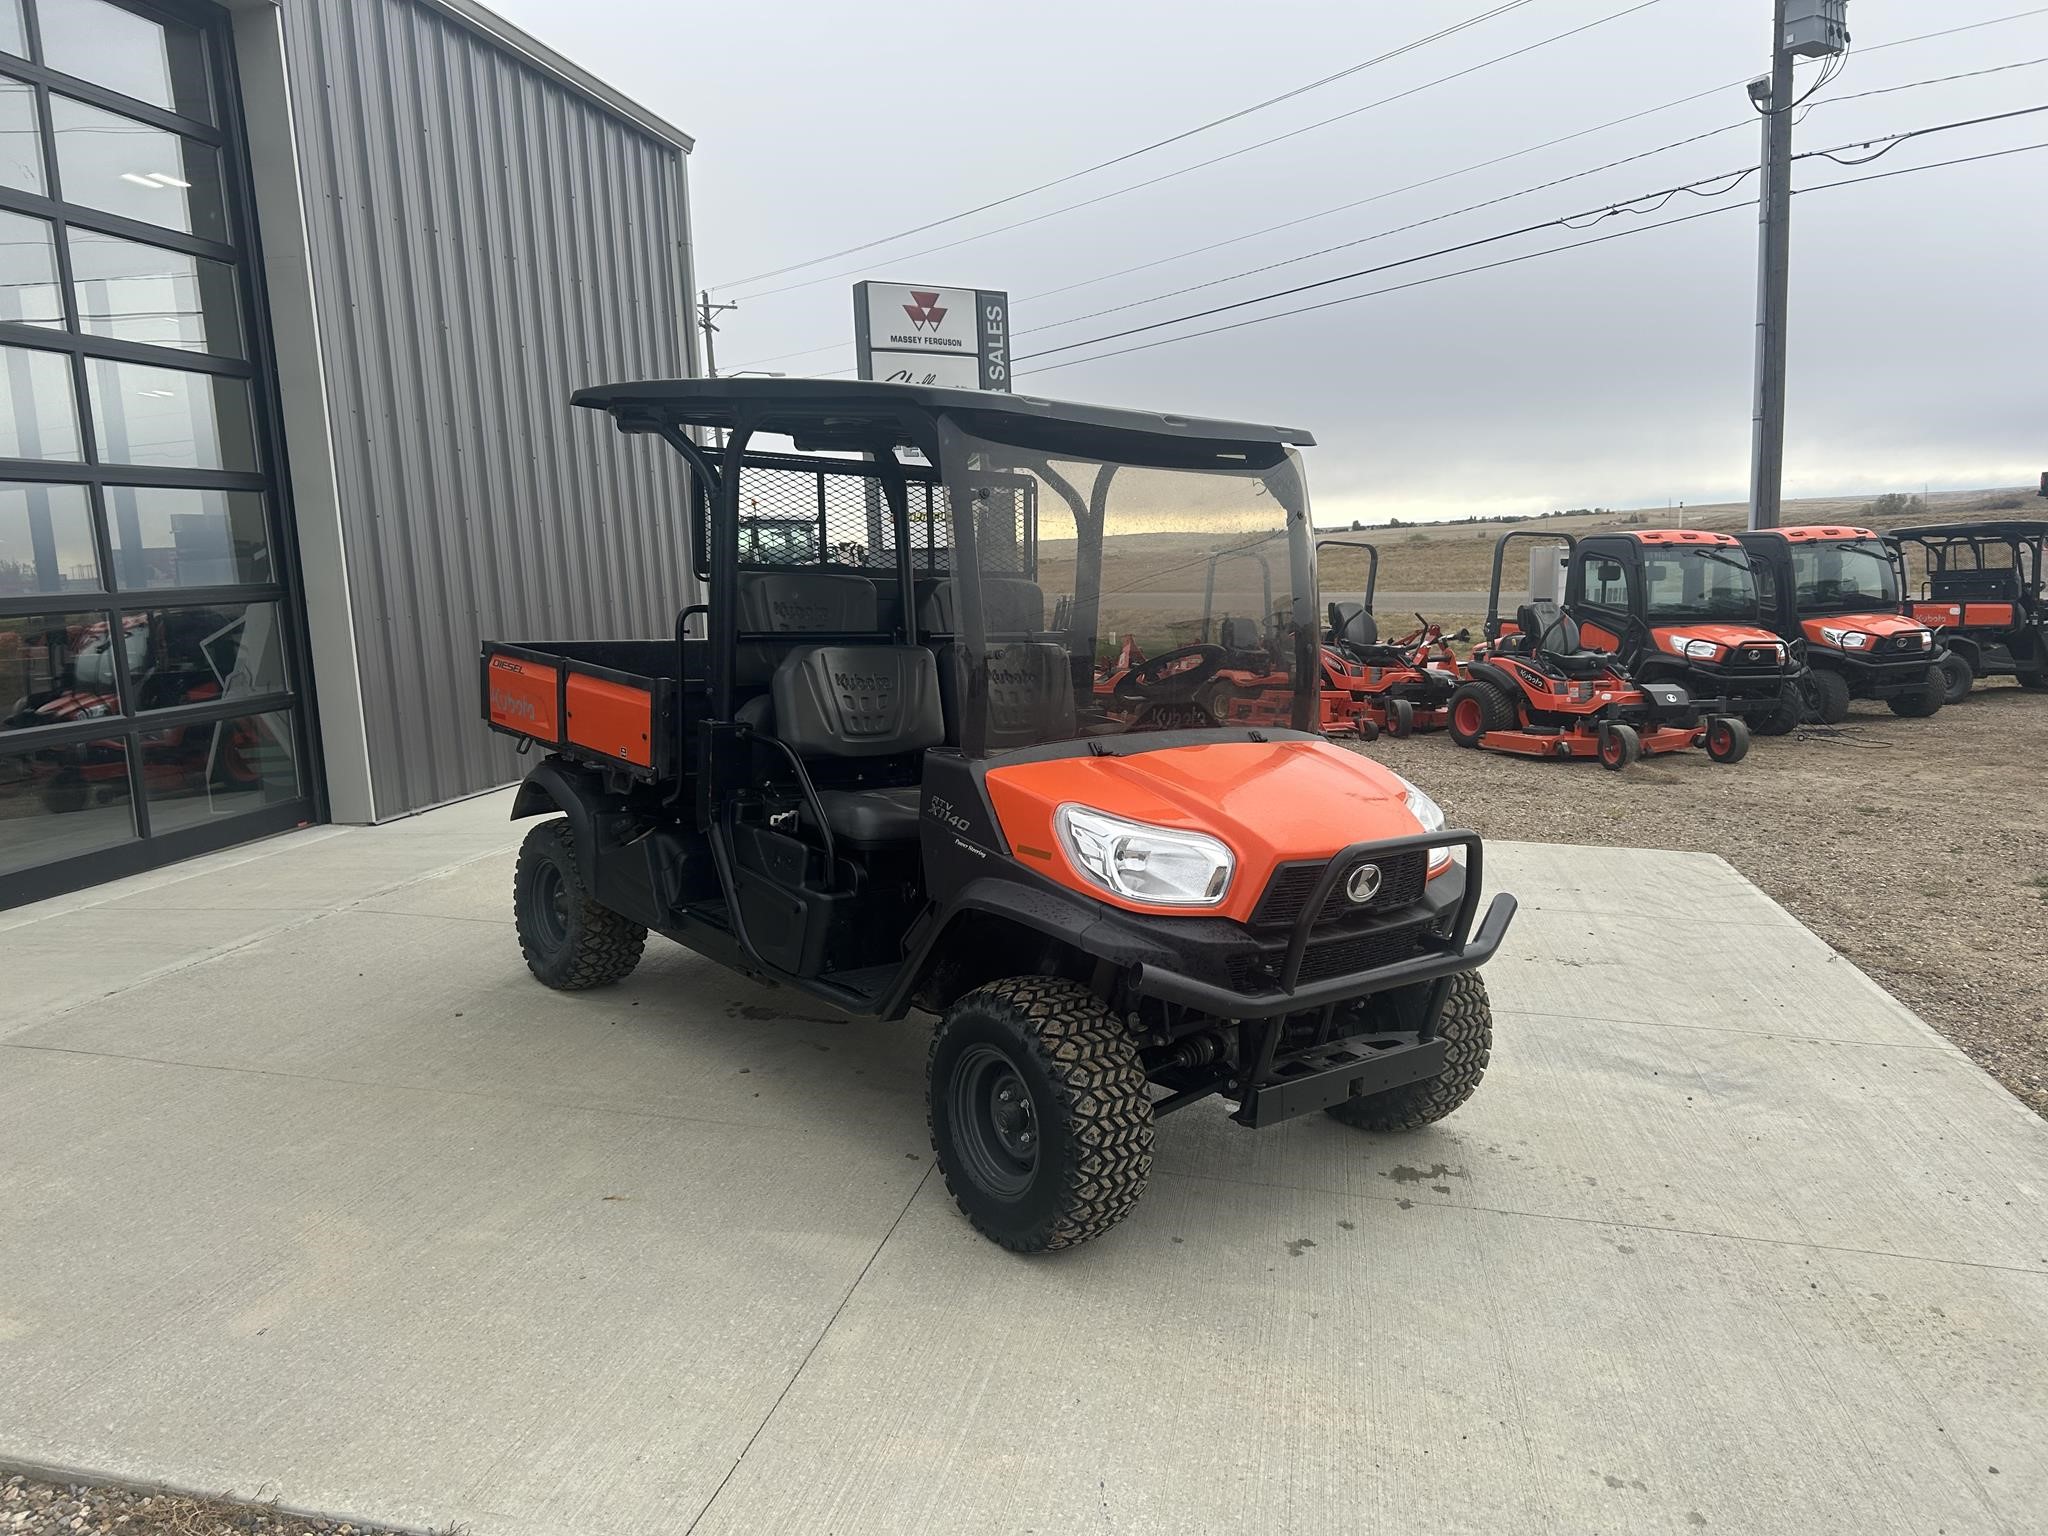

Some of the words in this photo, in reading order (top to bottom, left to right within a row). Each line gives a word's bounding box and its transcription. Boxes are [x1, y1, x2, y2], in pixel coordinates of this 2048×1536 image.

[890, 335, 922, 344] MASSEY
[924, 337, 962, 347] FERGUSON
[986, 305, 1005, 381] SALES
[493, 659, 525, 675] DIESEL
[835, 672, 892, 691] Kubota
[1520, 669, 1543, 687] Kubota
[931, 795, 954, 811] RTV
[927, 803, 971, 832] X1140
